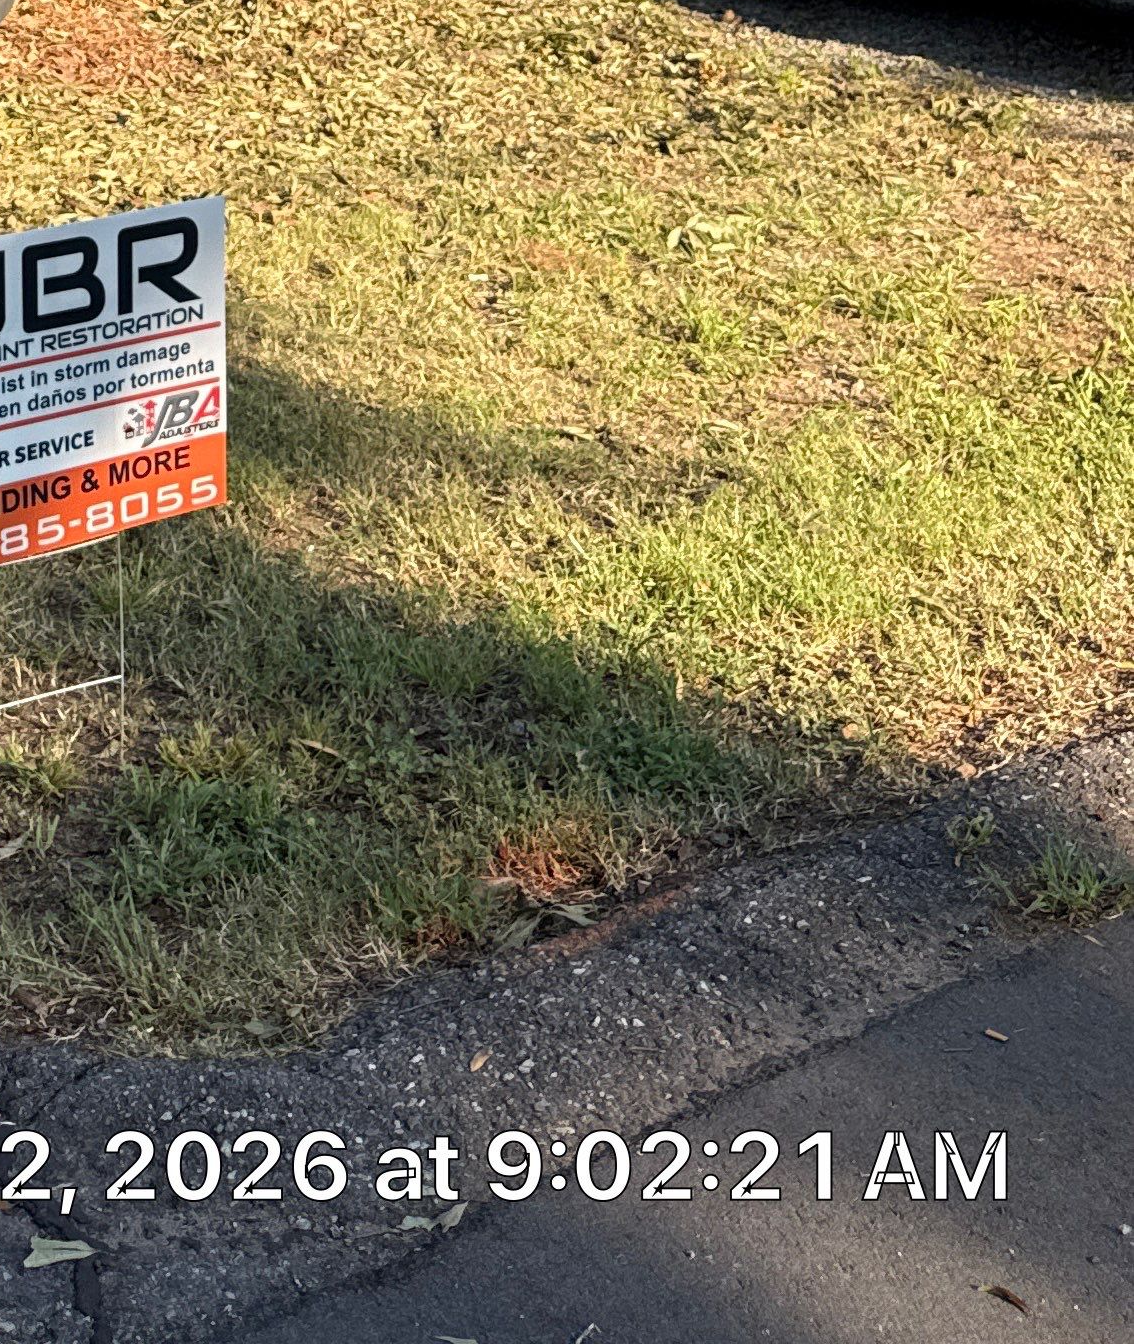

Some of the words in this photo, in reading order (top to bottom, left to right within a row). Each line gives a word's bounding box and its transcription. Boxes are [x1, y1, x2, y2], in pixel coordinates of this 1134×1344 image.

[28, 387, 86, 412] daños
[93, 378, 125, 401] por
[131, 359, 215, 388] tormenta
[31, 370, 48, 387] in
[55, 360, 110, 382] storm
[117, 342, 190, 368] damage
[141, 386, 220, 448] JBA
[15, 430, 94, 463] SERVICE
[81, 469, 100, 493] &
[109, 445, 190, 486] MORE
